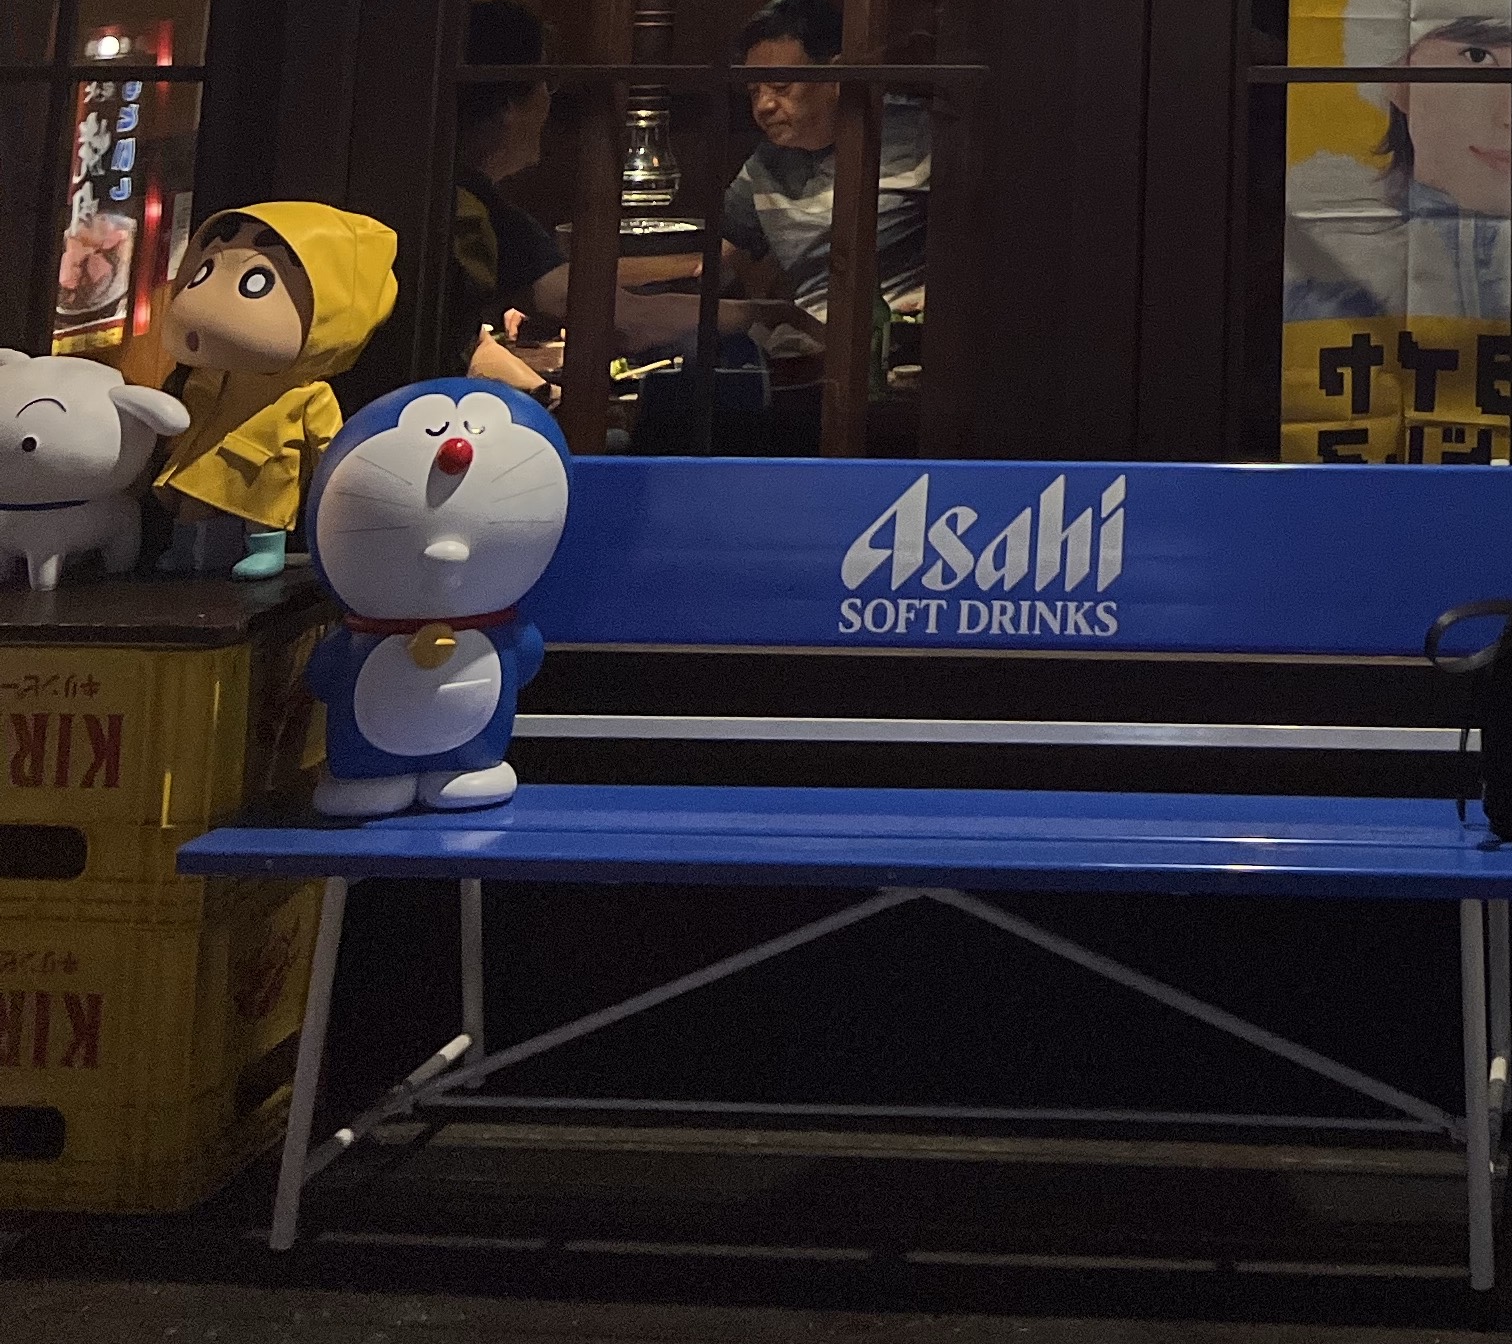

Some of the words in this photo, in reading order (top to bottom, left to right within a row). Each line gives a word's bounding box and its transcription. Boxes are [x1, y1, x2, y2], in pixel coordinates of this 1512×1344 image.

[841, 472, 1126, 593] Asahi
[838, 598, 949, 634] SOFT
[957, 599, 1119, 637] DRINKS
